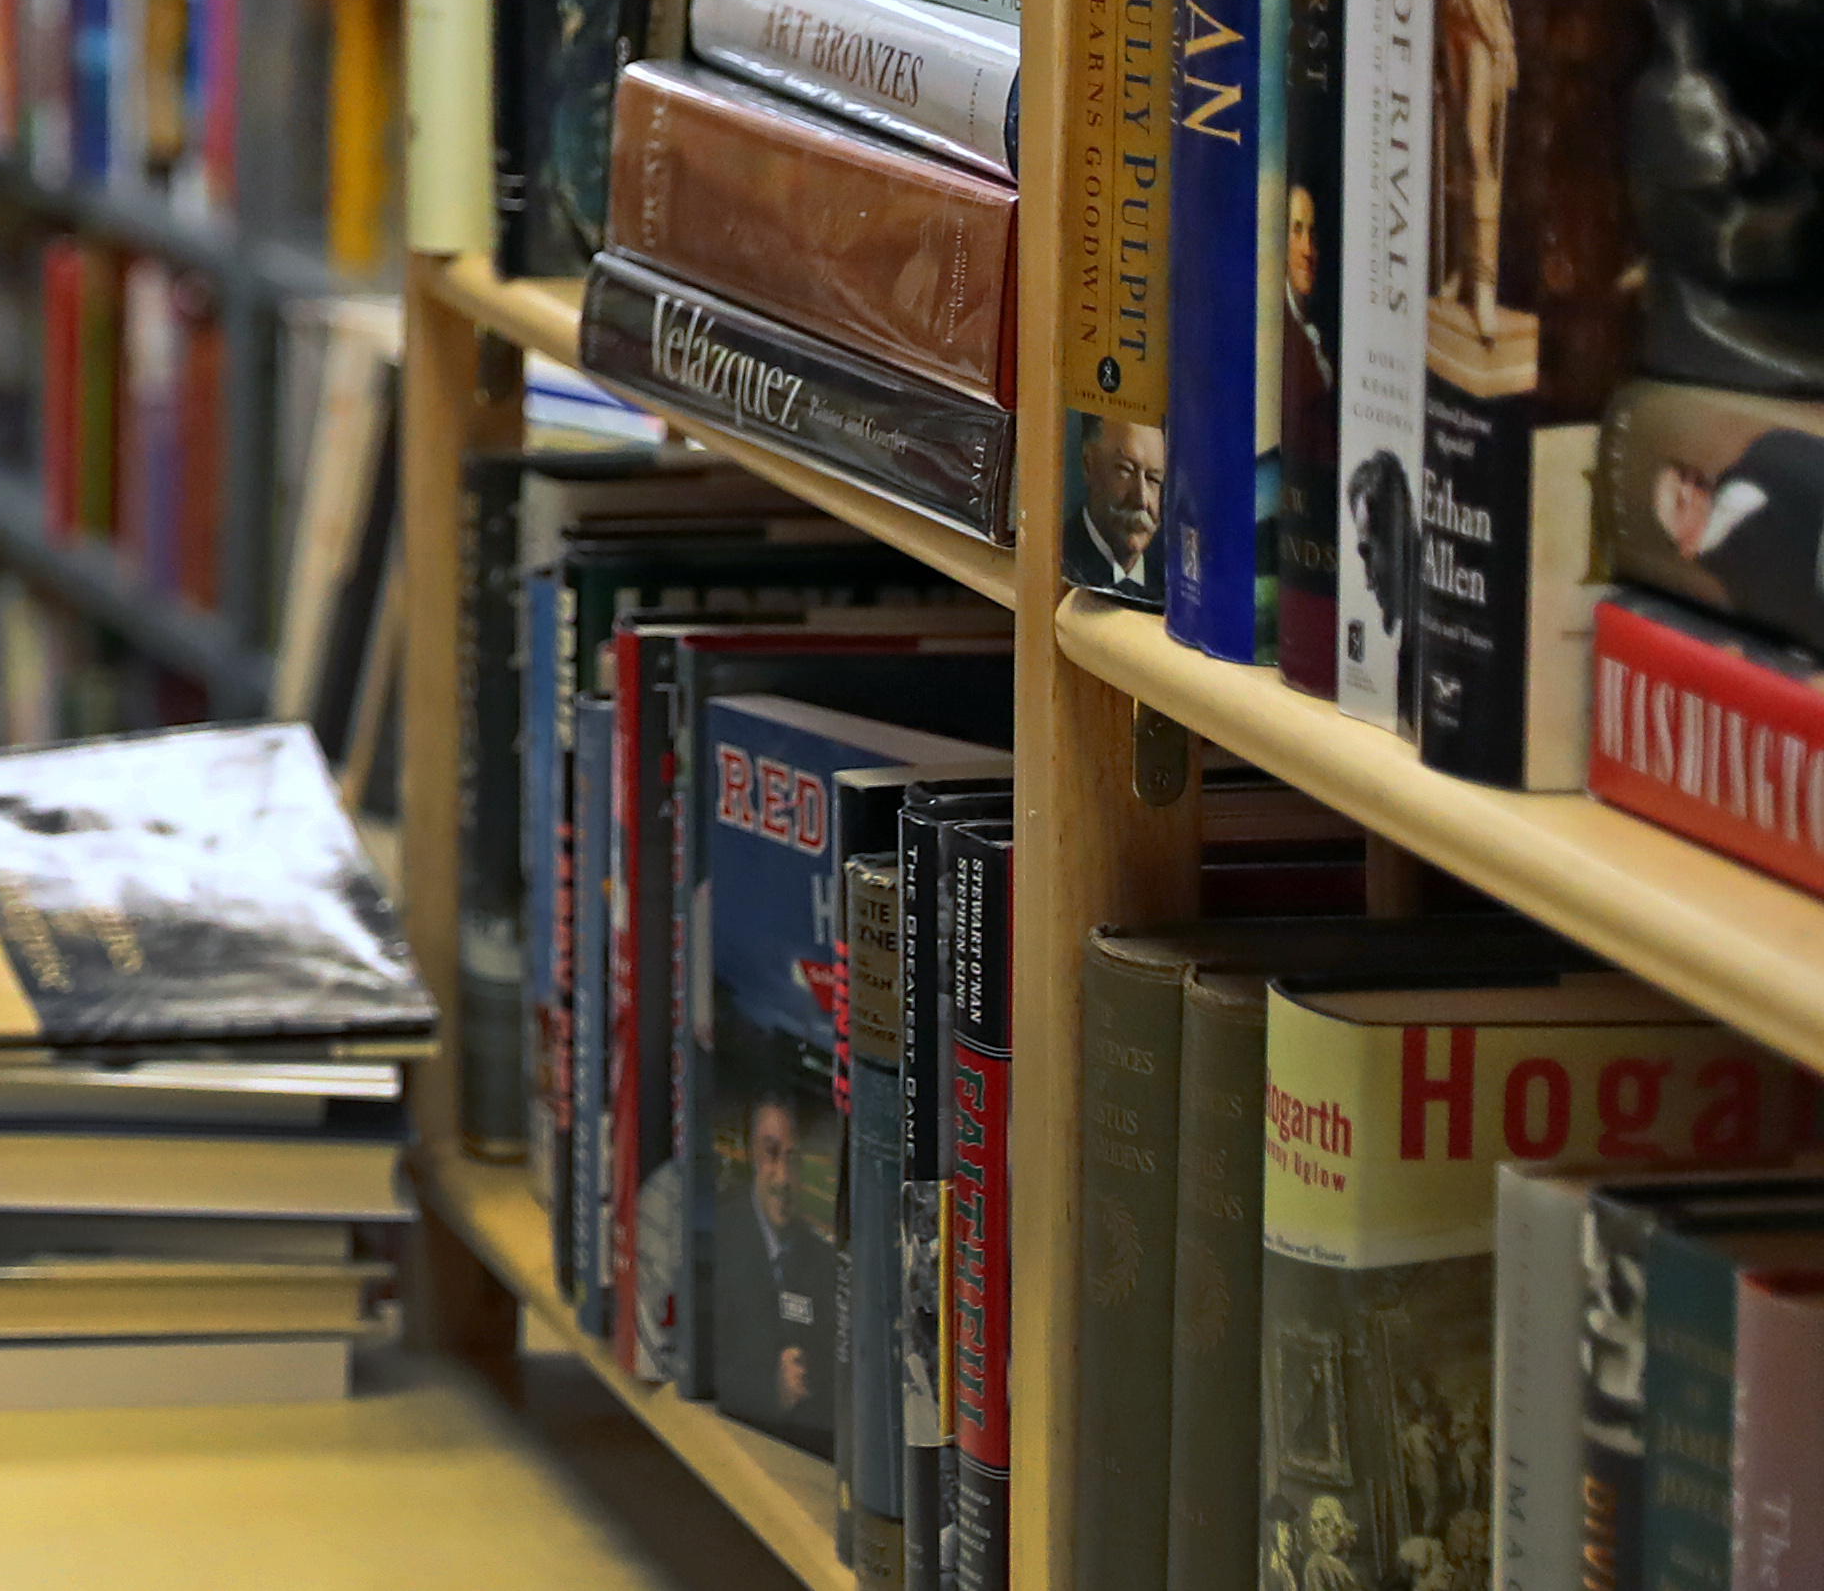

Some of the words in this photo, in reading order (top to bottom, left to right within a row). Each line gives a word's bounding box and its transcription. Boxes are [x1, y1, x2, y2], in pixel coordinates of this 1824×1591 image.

[760, 3, 813, 61] ART
[810, 18, 925, 109] BRONZES
[1370, 85, 1383, 191] ABRAHAM
[1080, 145, 1103, 346] GOODWIN
[1369, 201, 1382, 305] LINCOLN
[1386, 90, 1412, 317] RIVALS
[1118, 153, 1158, 363] PULPIT
[650, 291, 804, 433] Velázquez
[967, 435, 988, 507] YALE
[1422, 466, 1492, 543] Ethan
[1422, 533, 1486, 605] Allen
[715, 741, 829, 858] RED
[1596, 654, 1824, 859] WASHINGTO
[905, 843, 919, 903] THE
[954, 855, 968, 956] STEPHEN
[968, 856, 984, 960] STEWART
[903, 913, 918, 1066] GREATEST
[954, 957, 967, 1010] KING
[968, 961, 983, 1025] O'NAN
[902, 1076, 917, 1160] GAME
[1399, 1026, 1824, 1163] Hoga
[1294, 1149, 1347, 1193] Uglow
